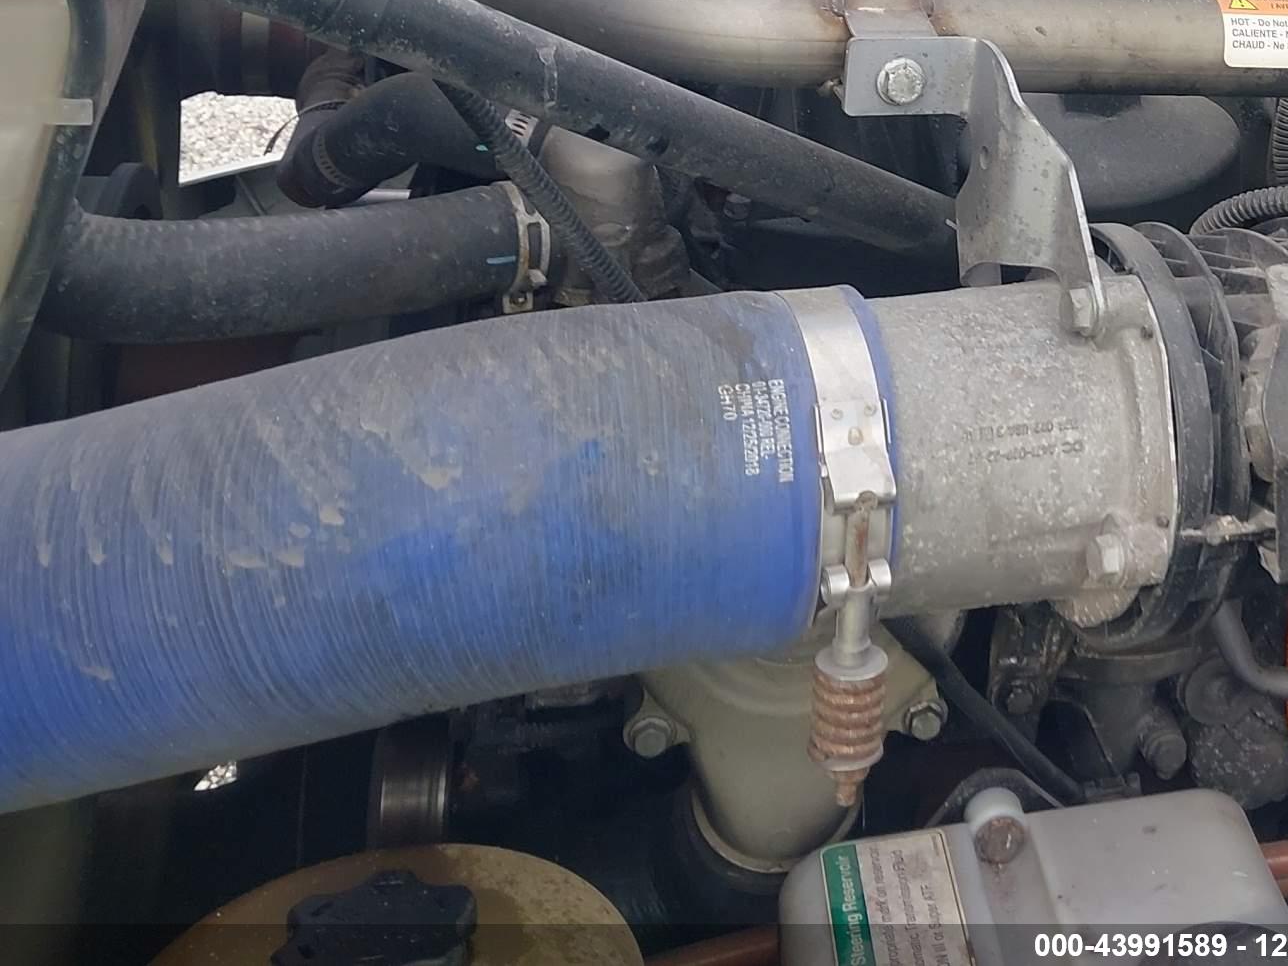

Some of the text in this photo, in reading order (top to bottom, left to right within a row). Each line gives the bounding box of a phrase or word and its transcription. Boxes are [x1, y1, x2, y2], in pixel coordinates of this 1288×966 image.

[1230, 17, 1250, 26] HOT
[1258, 19, 1270, 27] Do
[1272, 19, 1288, 28] Not
[1232, 28, 1277, 38] CALIENTE
[1232, 40, 1265, 50] CHAUD
[1273, 41, 1285, 50] Ne
[735, 383, 755, 417] CHINA
[768, 378, 794, 482] ENGINE CONNECTION
[890, 849, 906, 873] Fluid
[876, 885, 887, 901] on
[896, 873, 917, 931] Transmission
[920, 884, 935, 902] ATF
[835, 855, 867, 966] Steering Reservoir
[874, 898, 892, 923] mark
[927, 903, 942, 931] Super
[934, 930, 944, 941] or
